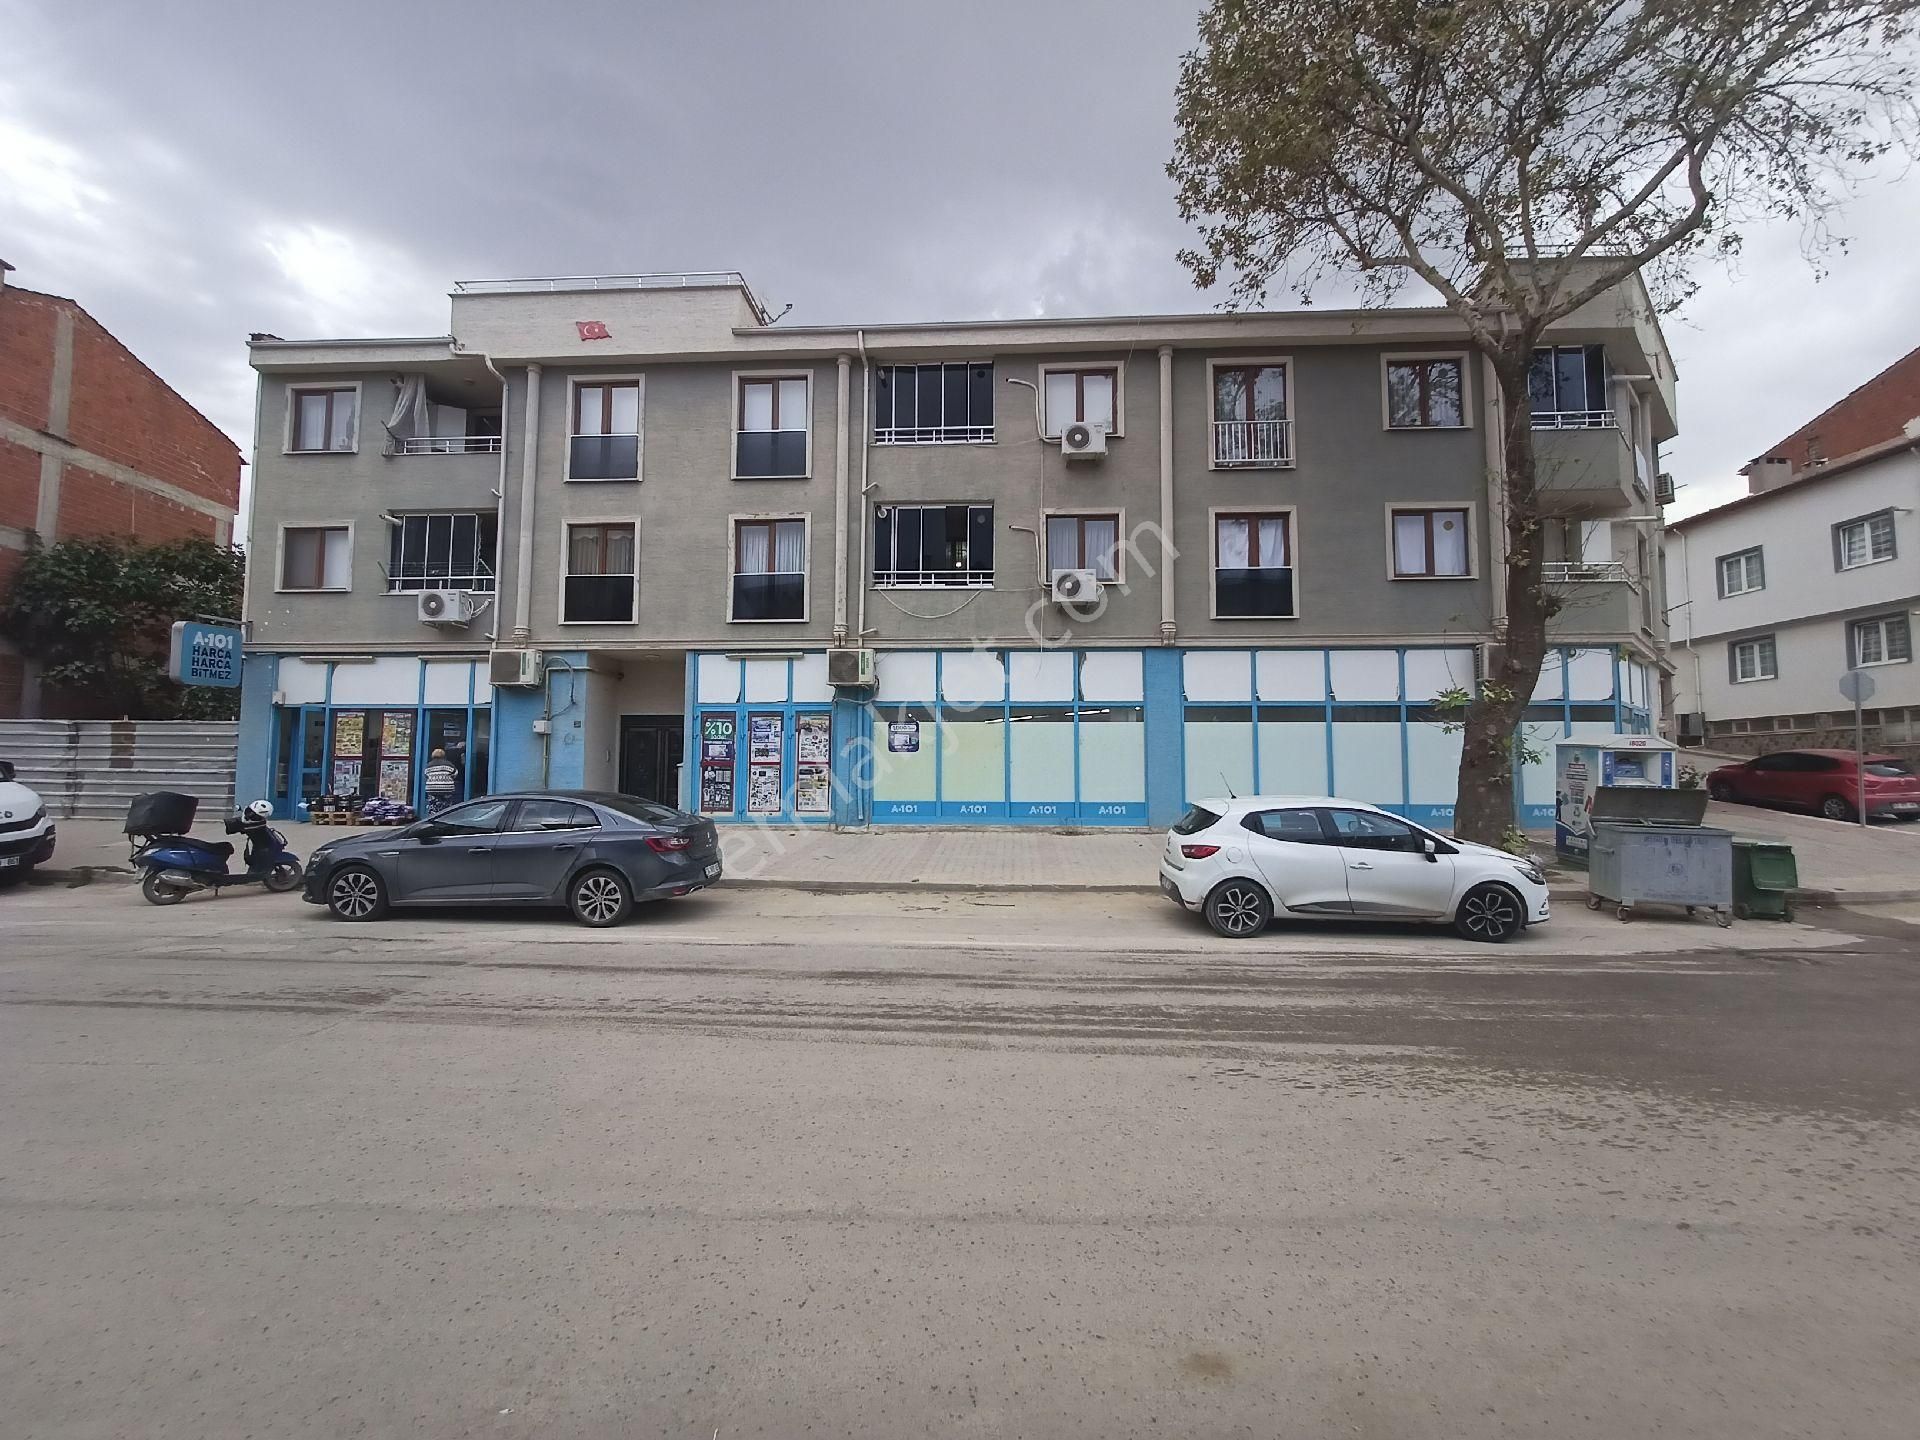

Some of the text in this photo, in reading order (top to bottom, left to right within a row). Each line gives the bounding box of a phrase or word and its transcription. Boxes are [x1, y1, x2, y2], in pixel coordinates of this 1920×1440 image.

[192, 646, 232, 659] HARCA
[192, 657, 231, 669] HARCA
[191, 668, 232, 680] BİTMEZ
[705, 722, 732, 734] %10
